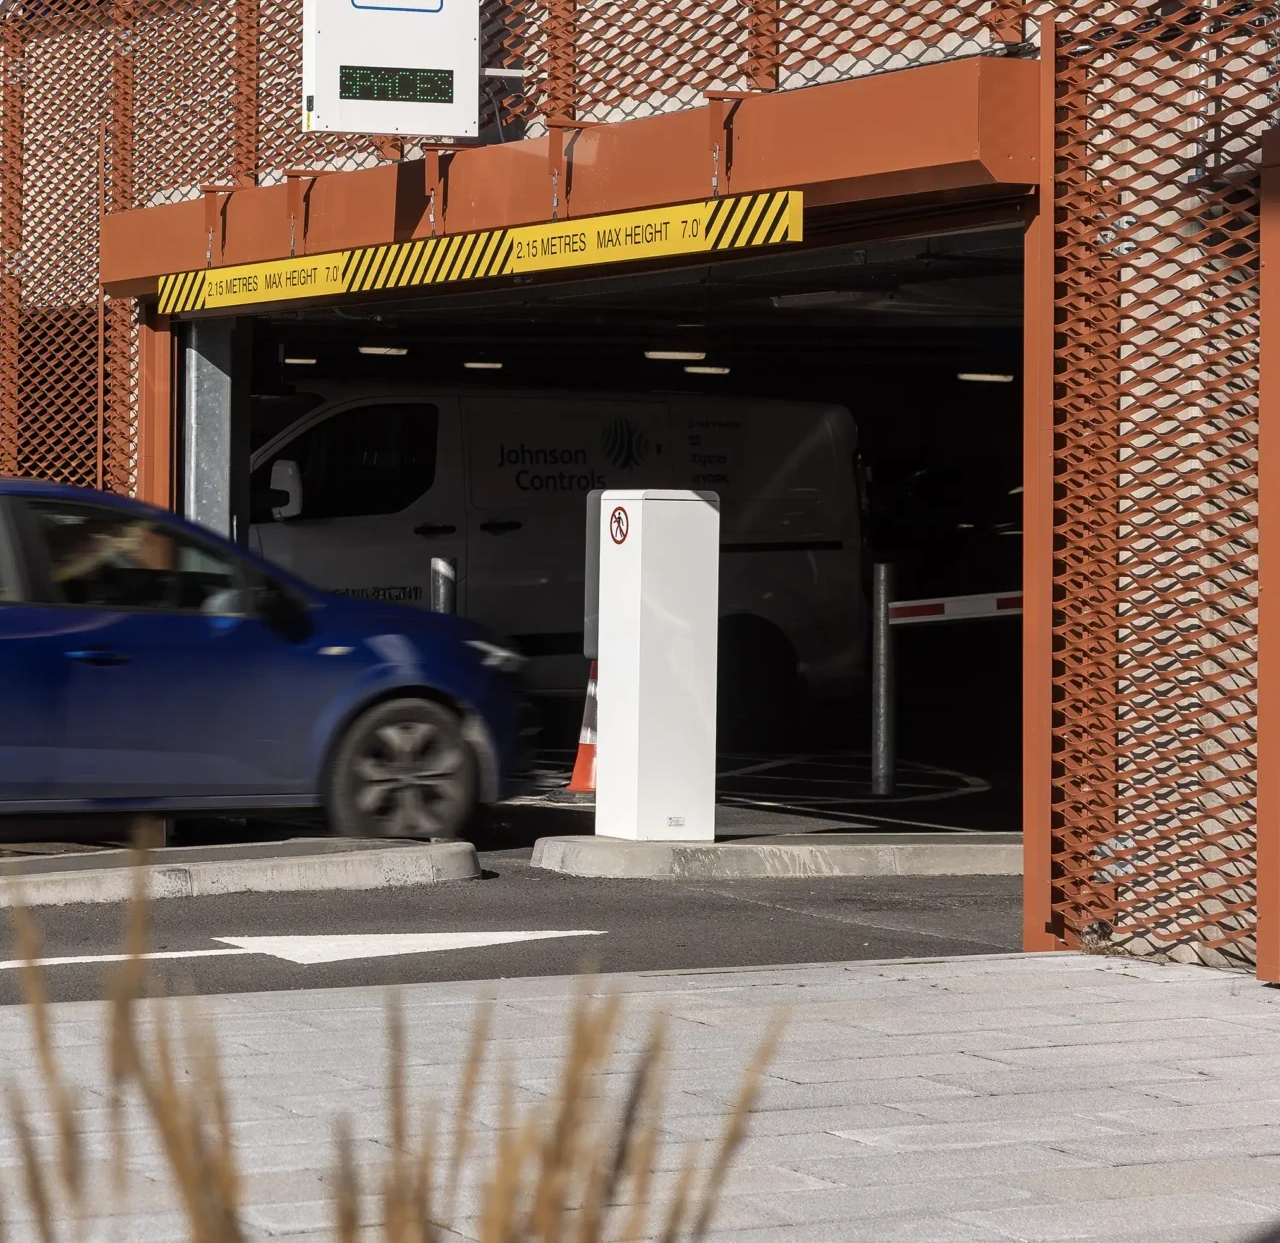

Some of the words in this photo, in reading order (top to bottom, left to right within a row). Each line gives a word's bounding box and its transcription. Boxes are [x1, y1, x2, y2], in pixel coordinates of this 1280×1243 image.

[339, 69, 452, 100] SPACES
[516, 240, 538, 259] 2.15
[541, 232, 586, 256] METRES
[597, 228, 622, 249] MAX
[625, 221, 670, 245] HEIGHT
[207, 280, 224, 297] 2.15
[225, 275, 259, 295] METRES
[264, 273, 283, 290] MAX
[286, 267, 318, 287] HEIGHT
[497, 443, 587, 467] Johnson
[515, 468, 607, 490] Controls
